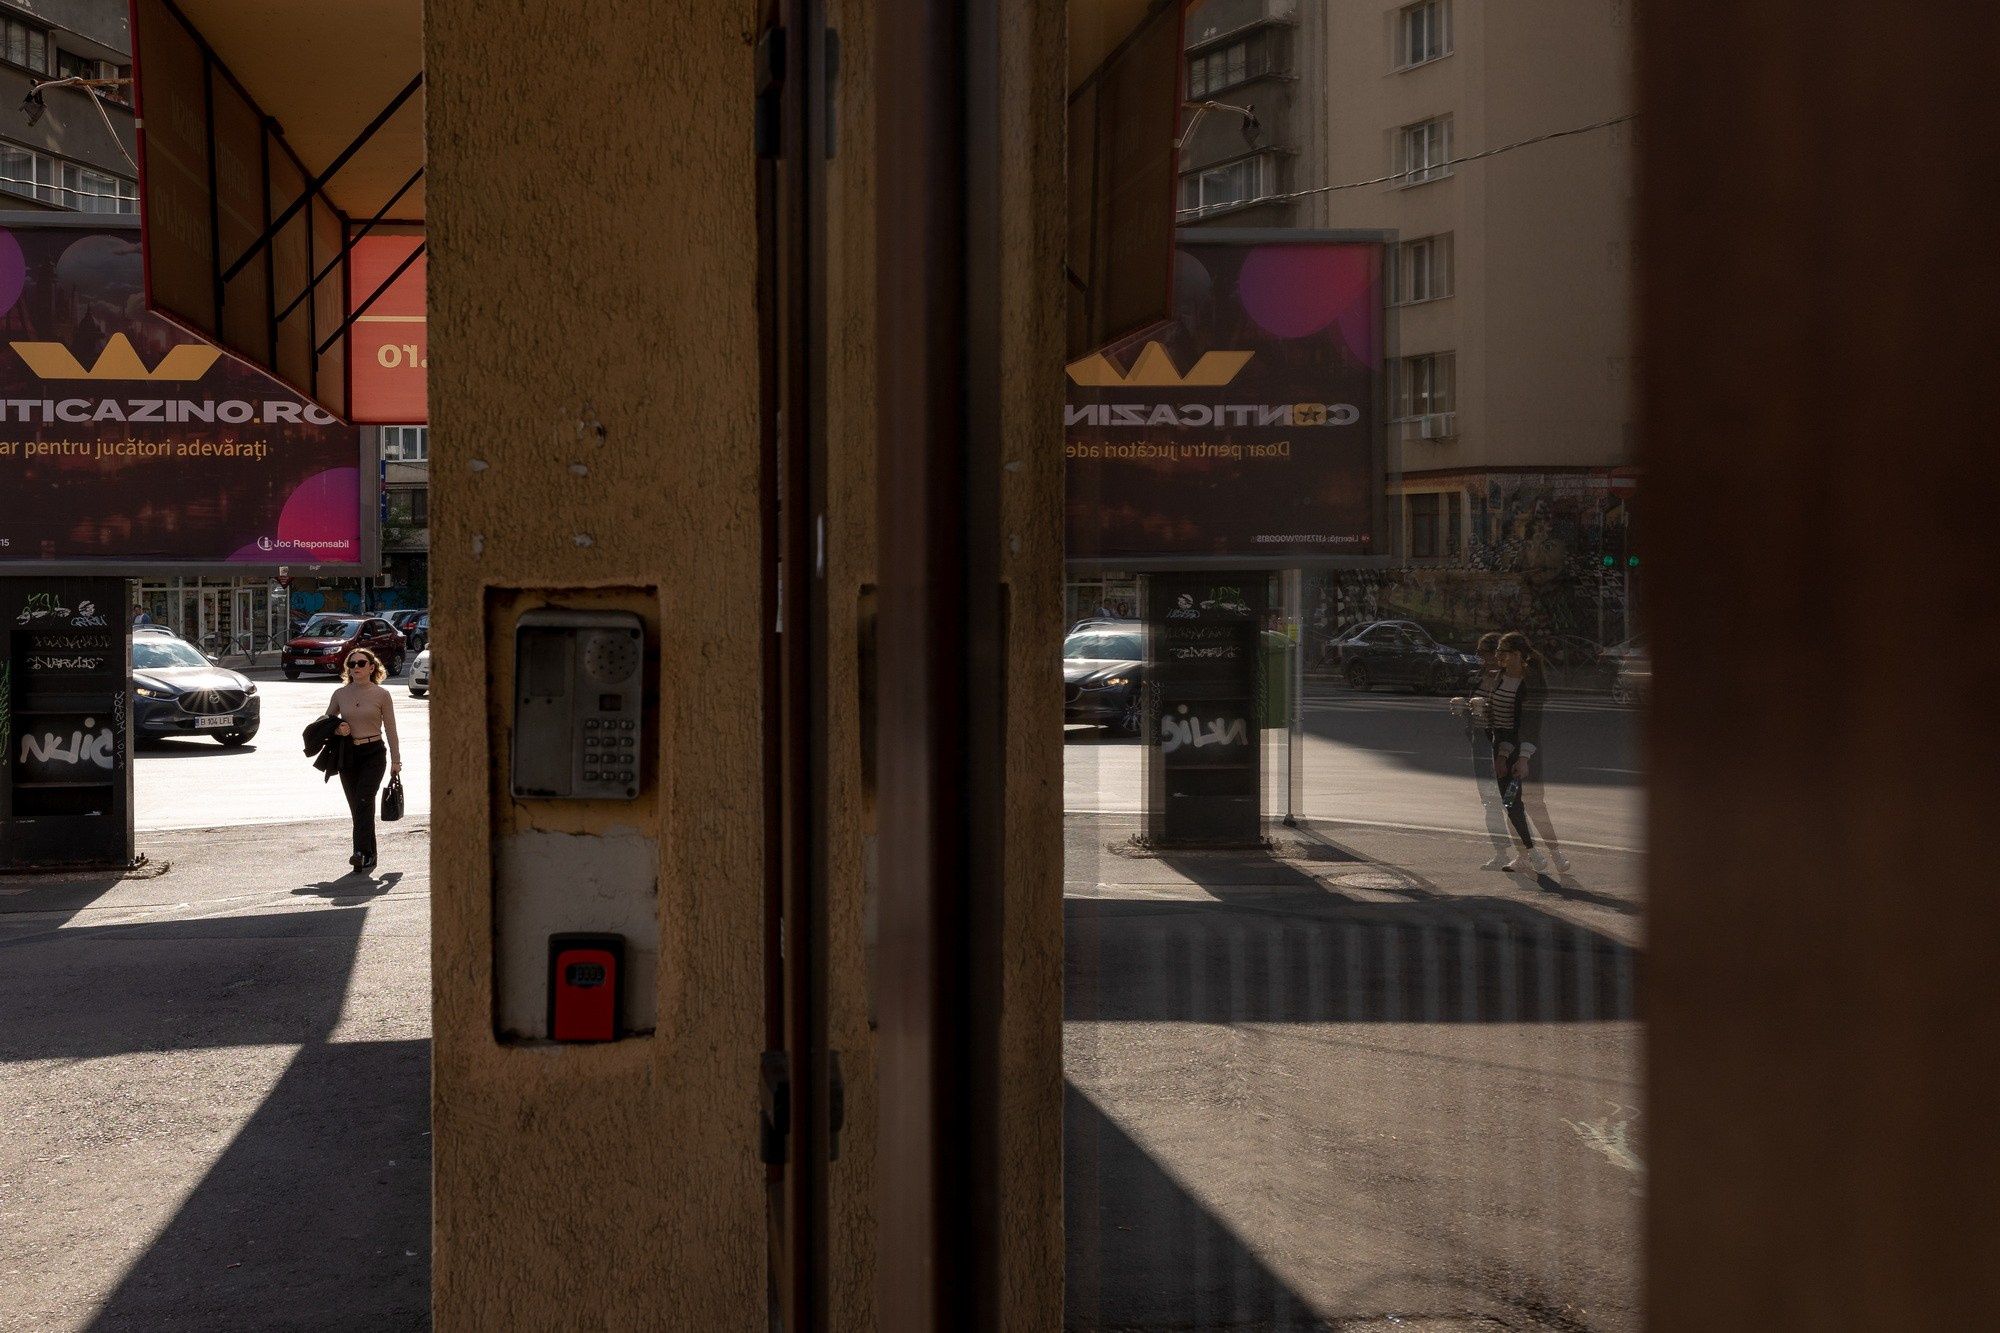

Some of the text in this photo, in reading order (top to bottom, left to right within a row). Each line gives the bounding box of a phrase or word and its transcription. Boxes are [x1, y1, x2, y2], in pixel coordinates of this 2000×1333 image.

[0, 398, 337, 425] TICAZINO.RO
[25, 439, 91, 459] pentru
[95, 439, 171, 460] jucători
[177, 439, 267, 462] adevărați
[0, 538, 10, 547] 15
[274, 539, 350, 550] Joc Responsabil
[201, 718, 206, 726] B
[220, 716, 231, 724] LFL
